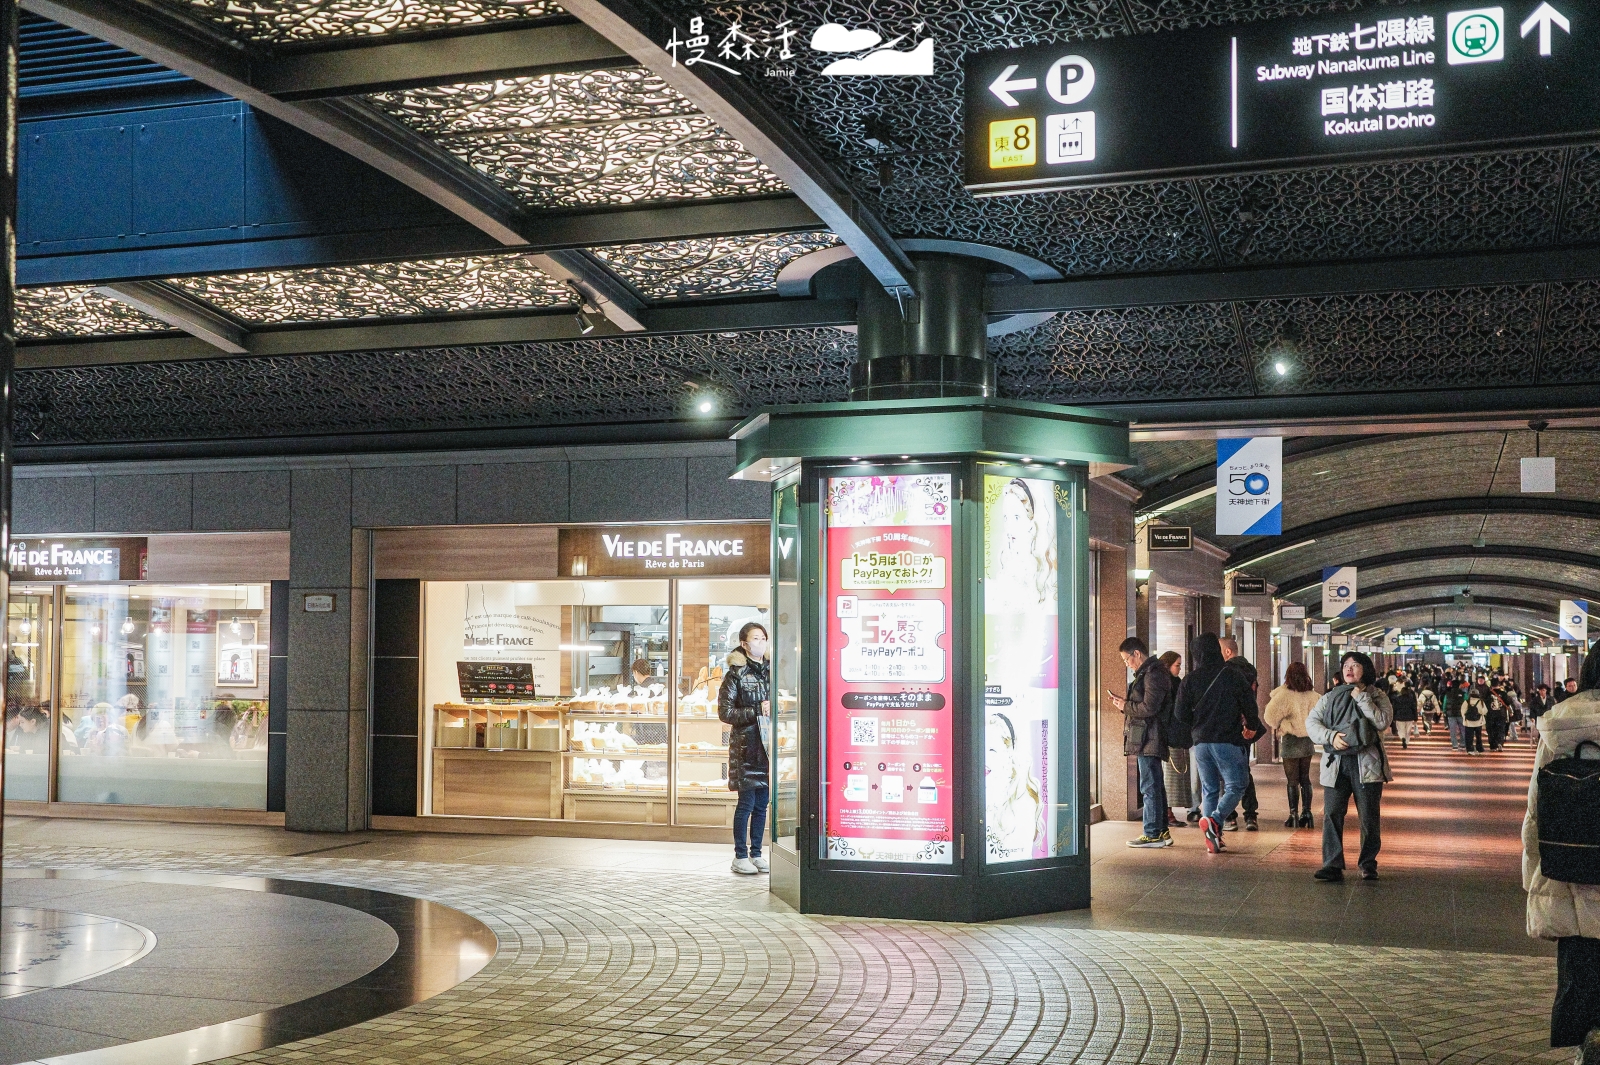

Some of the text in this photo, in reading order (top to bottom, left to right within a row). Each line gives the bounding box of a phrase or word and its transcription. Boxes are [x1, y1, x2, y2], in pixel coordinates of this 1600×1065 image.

[1292, 15, 1435, 56] 地下鉄七隈線
[1256, 50, 1435, 82] Subway Nanakuma Line
[1321, 78, 1435, 116] 国体道路
[1324, 112, 1435, 135] Kokutai Dohro
[1002, 154, 1024, 163] EAST
[1228, 472, 1270, 496] 50
[1228, 498, 1270, 506] 天神地下街
[602, 533, 744, 557] VIE DE FRANCE
[29, 550, 49, 565] DE
[51, 544, 113, 565] FRANCE
[645, 559, 705, 568] Rêve de Paris
[34, 567, 82, 576] Rêve de Paris
[853, 568, 933, 580] PayPayでおトク!
[897, 620, 923, 632] 戻って
[496, 634, 534, 645] FRANCE
[899, 632, 917, 644] くる
[861, 646, 924, 657] PayPayクーポン
